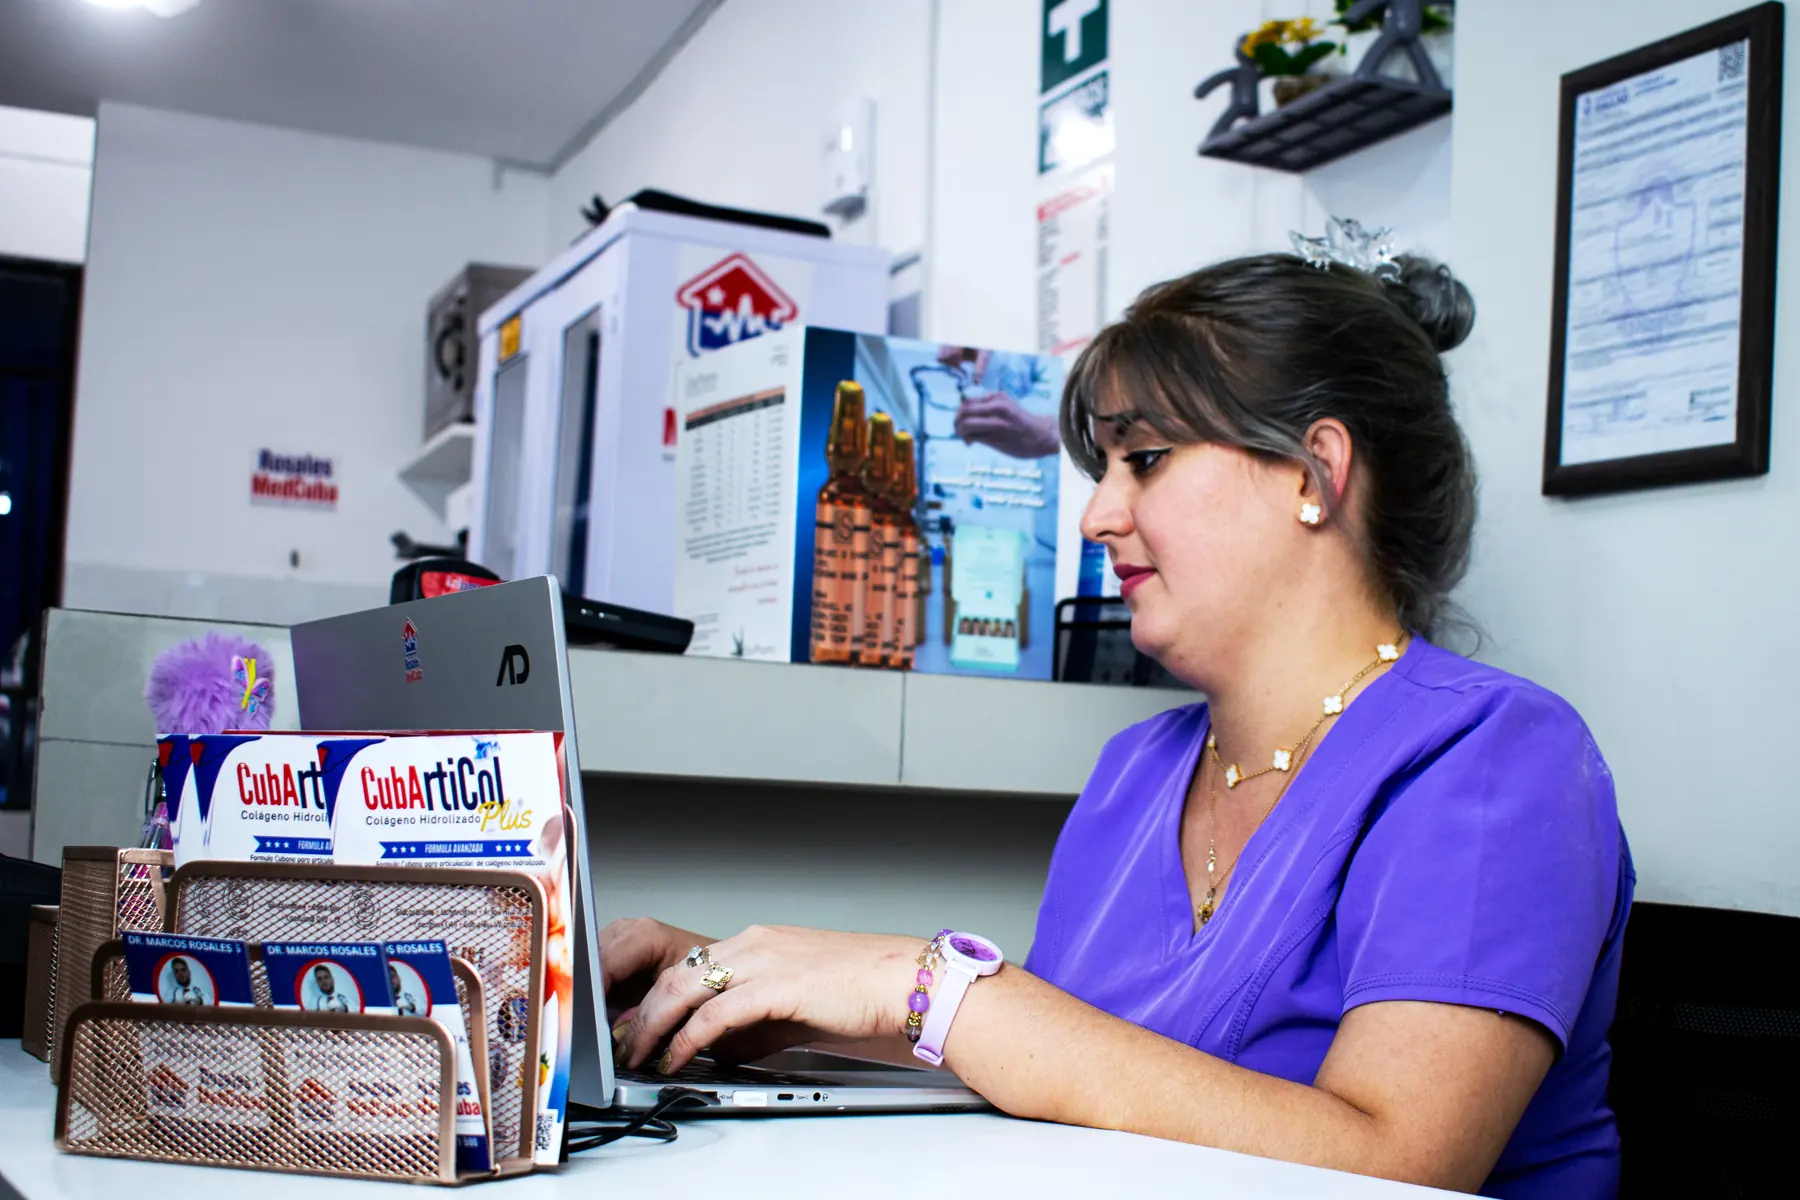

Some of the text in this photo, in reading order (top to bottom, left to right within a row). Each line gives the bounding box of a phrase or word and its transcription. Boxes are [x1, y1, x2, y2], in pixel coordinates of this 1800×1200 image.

[361, 756, 504, 811] CubArtiCol
[241, 810, 290, 823] Colágeno
[366, 814, 481, 828] Colágeno Hidrolizado
[478, 798, 533, 832] Plus
[297, 839, 325, 851] FORMULA
[424, 843, 484, 854] FORMULA AVANZADA
[128, 934, 144, 945] DR.
[146, 937, 188, 949] MARCOS
[188, 940, 233, 953] ROSALES
[397, 943, 444, 954] ROSALES
[267, 945, 377, 957] DR. MARCOS ROSALES
